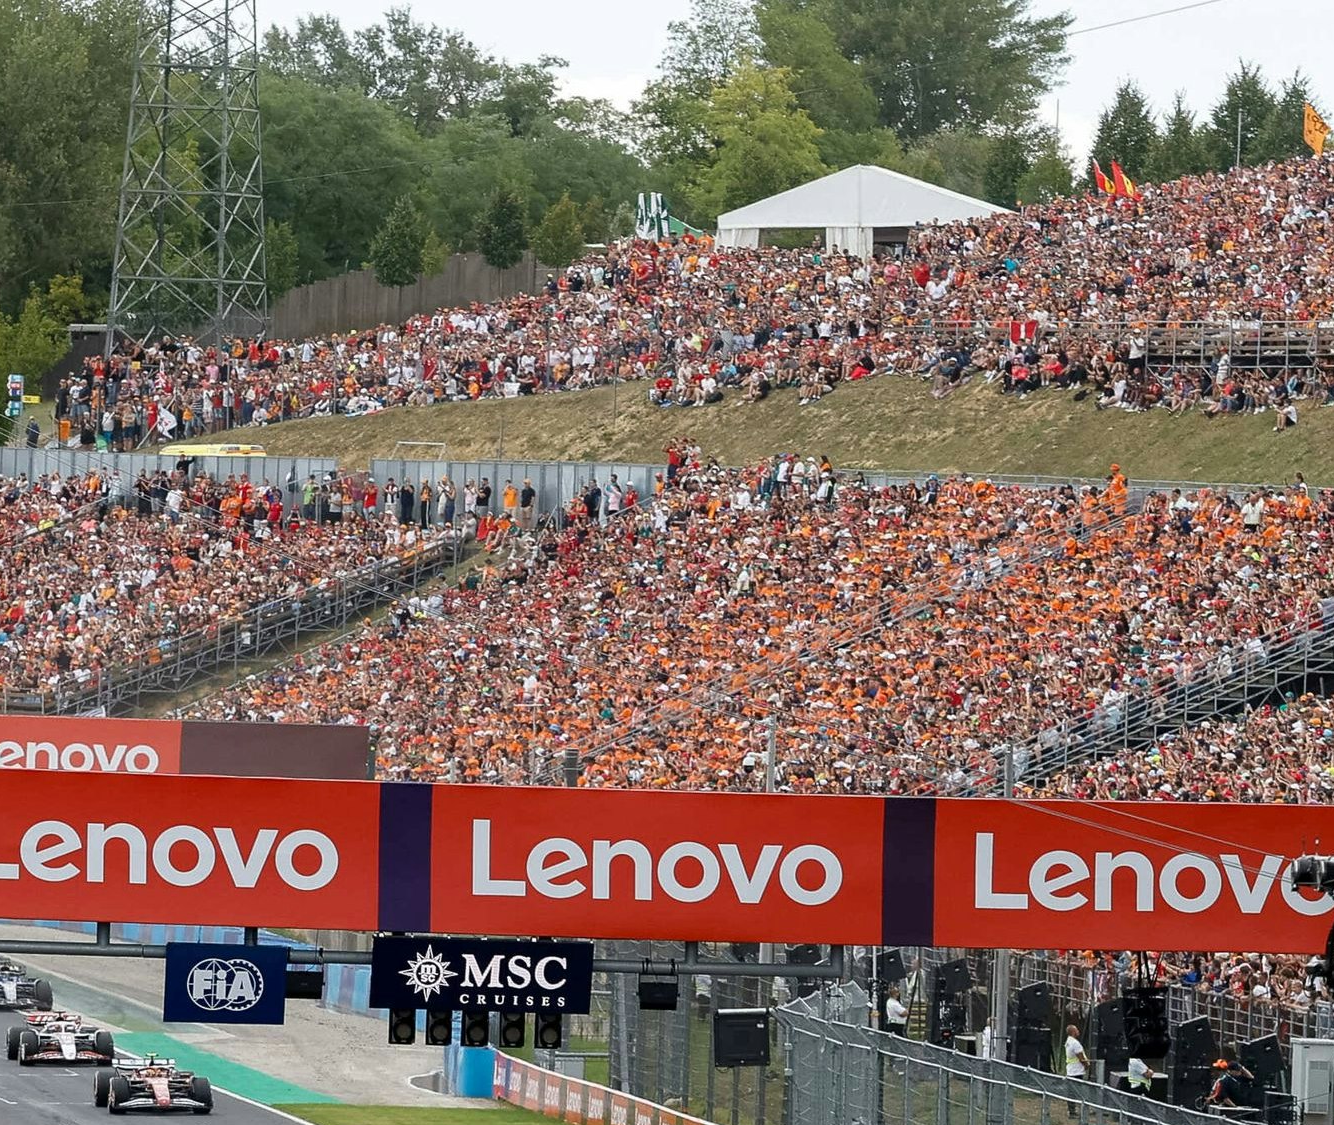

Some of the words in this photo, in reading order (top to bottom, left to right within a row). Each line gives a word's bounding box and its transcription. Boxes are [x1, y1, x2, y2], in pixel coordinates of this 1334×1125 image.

[472, 819, 843, 906] Lenovo
[460, 952, 567, 991] MSC
[459, 994, 565, 1008] CRUISES
